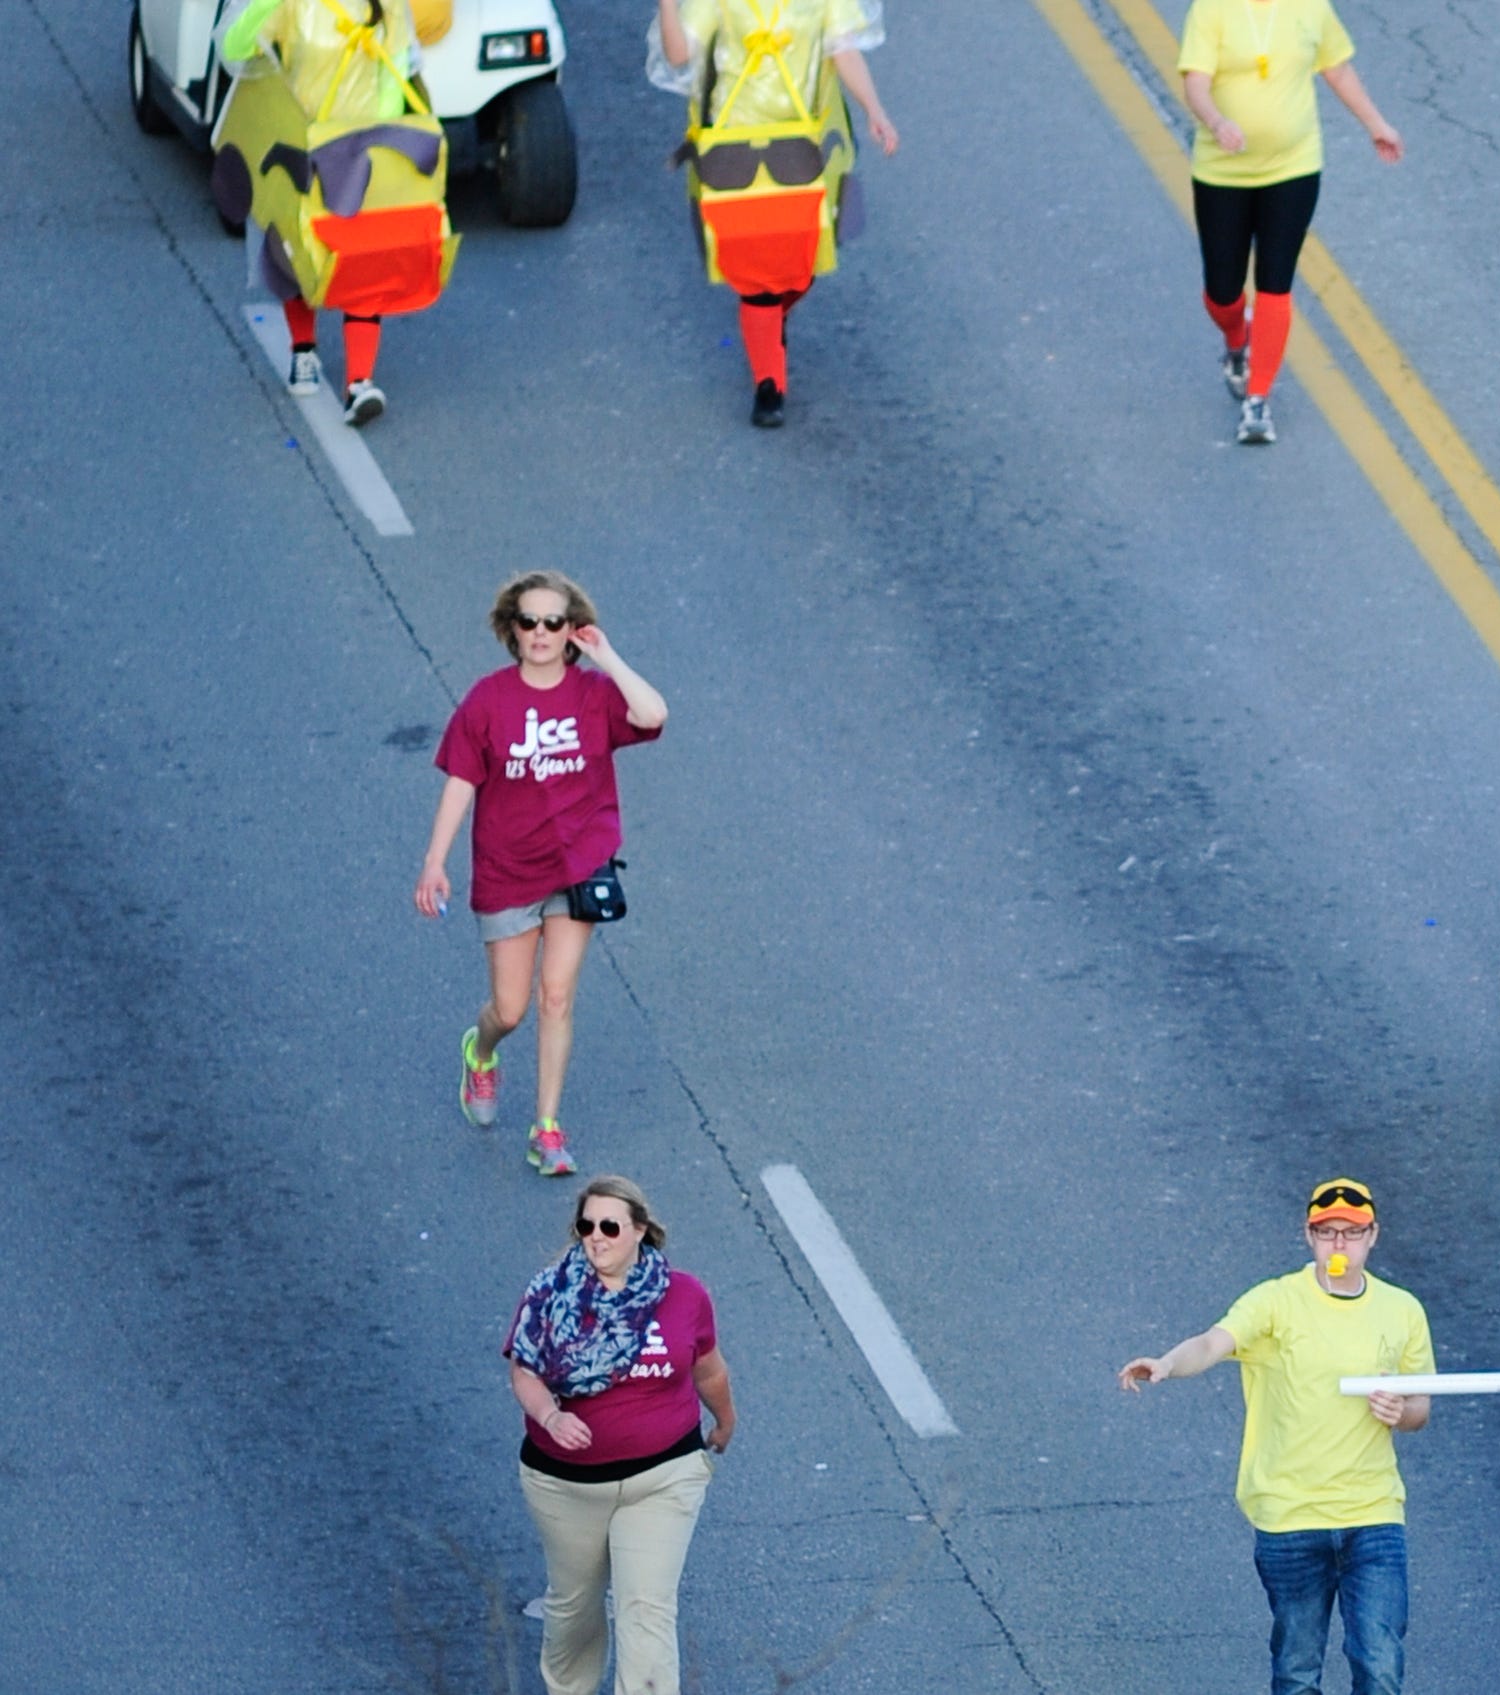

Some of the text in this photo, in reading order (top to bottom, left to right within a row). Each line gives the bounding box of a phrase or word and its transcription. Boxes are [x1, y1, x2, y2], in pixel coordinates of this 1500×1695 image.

[508, 706, 579, 758] jcc
[505, 753, 587, 783] 125 Years
[625, 1361, 675, 1380] ears
